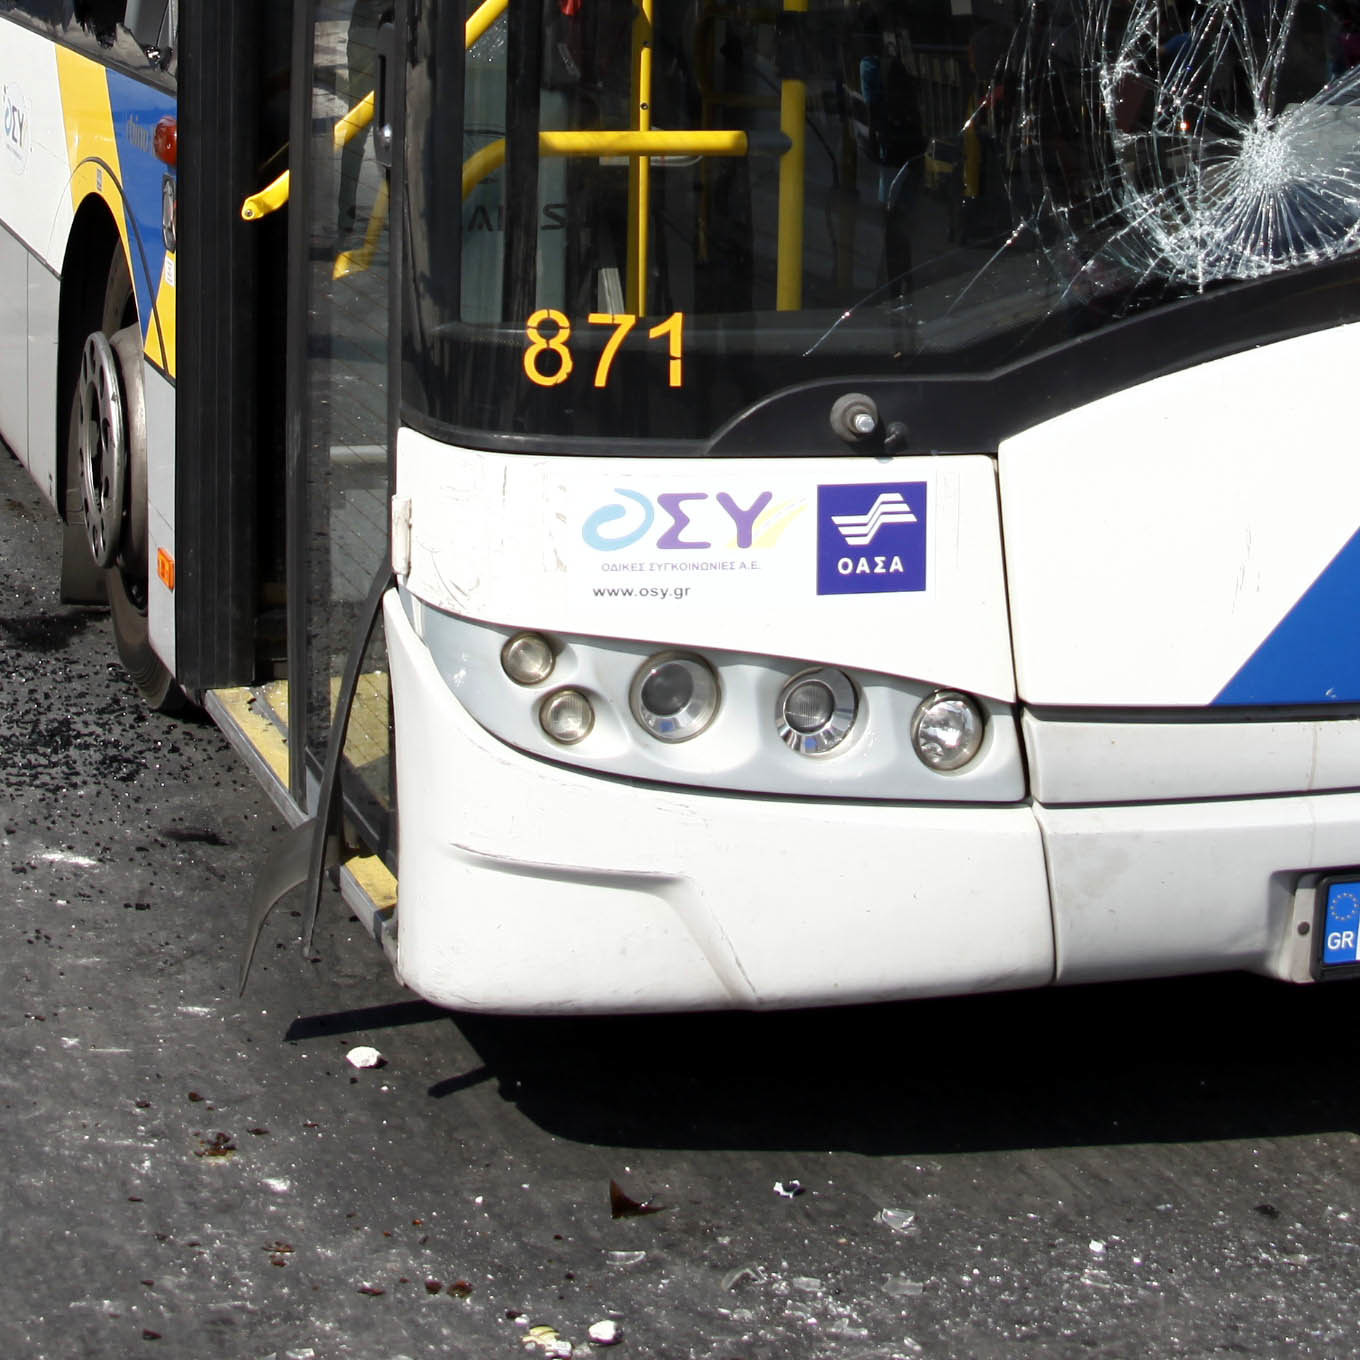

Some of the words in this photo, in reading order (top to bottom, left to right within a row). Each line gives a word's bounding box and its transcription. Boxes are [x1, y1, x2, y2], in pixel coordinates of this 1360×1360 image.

[524, 309, 683, 387] 871
[601, 562, 646, 572] ΟΔΙΚΕΣ
[649, 561, 736, 571] ΣΥΓΚΟΙΝΩΝΙΕΣ
[739, 560, 761, 570] Α.Ε.
[837, 555, 905, 576] ΟΑΣΑ
[592, 586, 692, 600] www.osy.gr
[1326, 930, 1355, 950] GR
